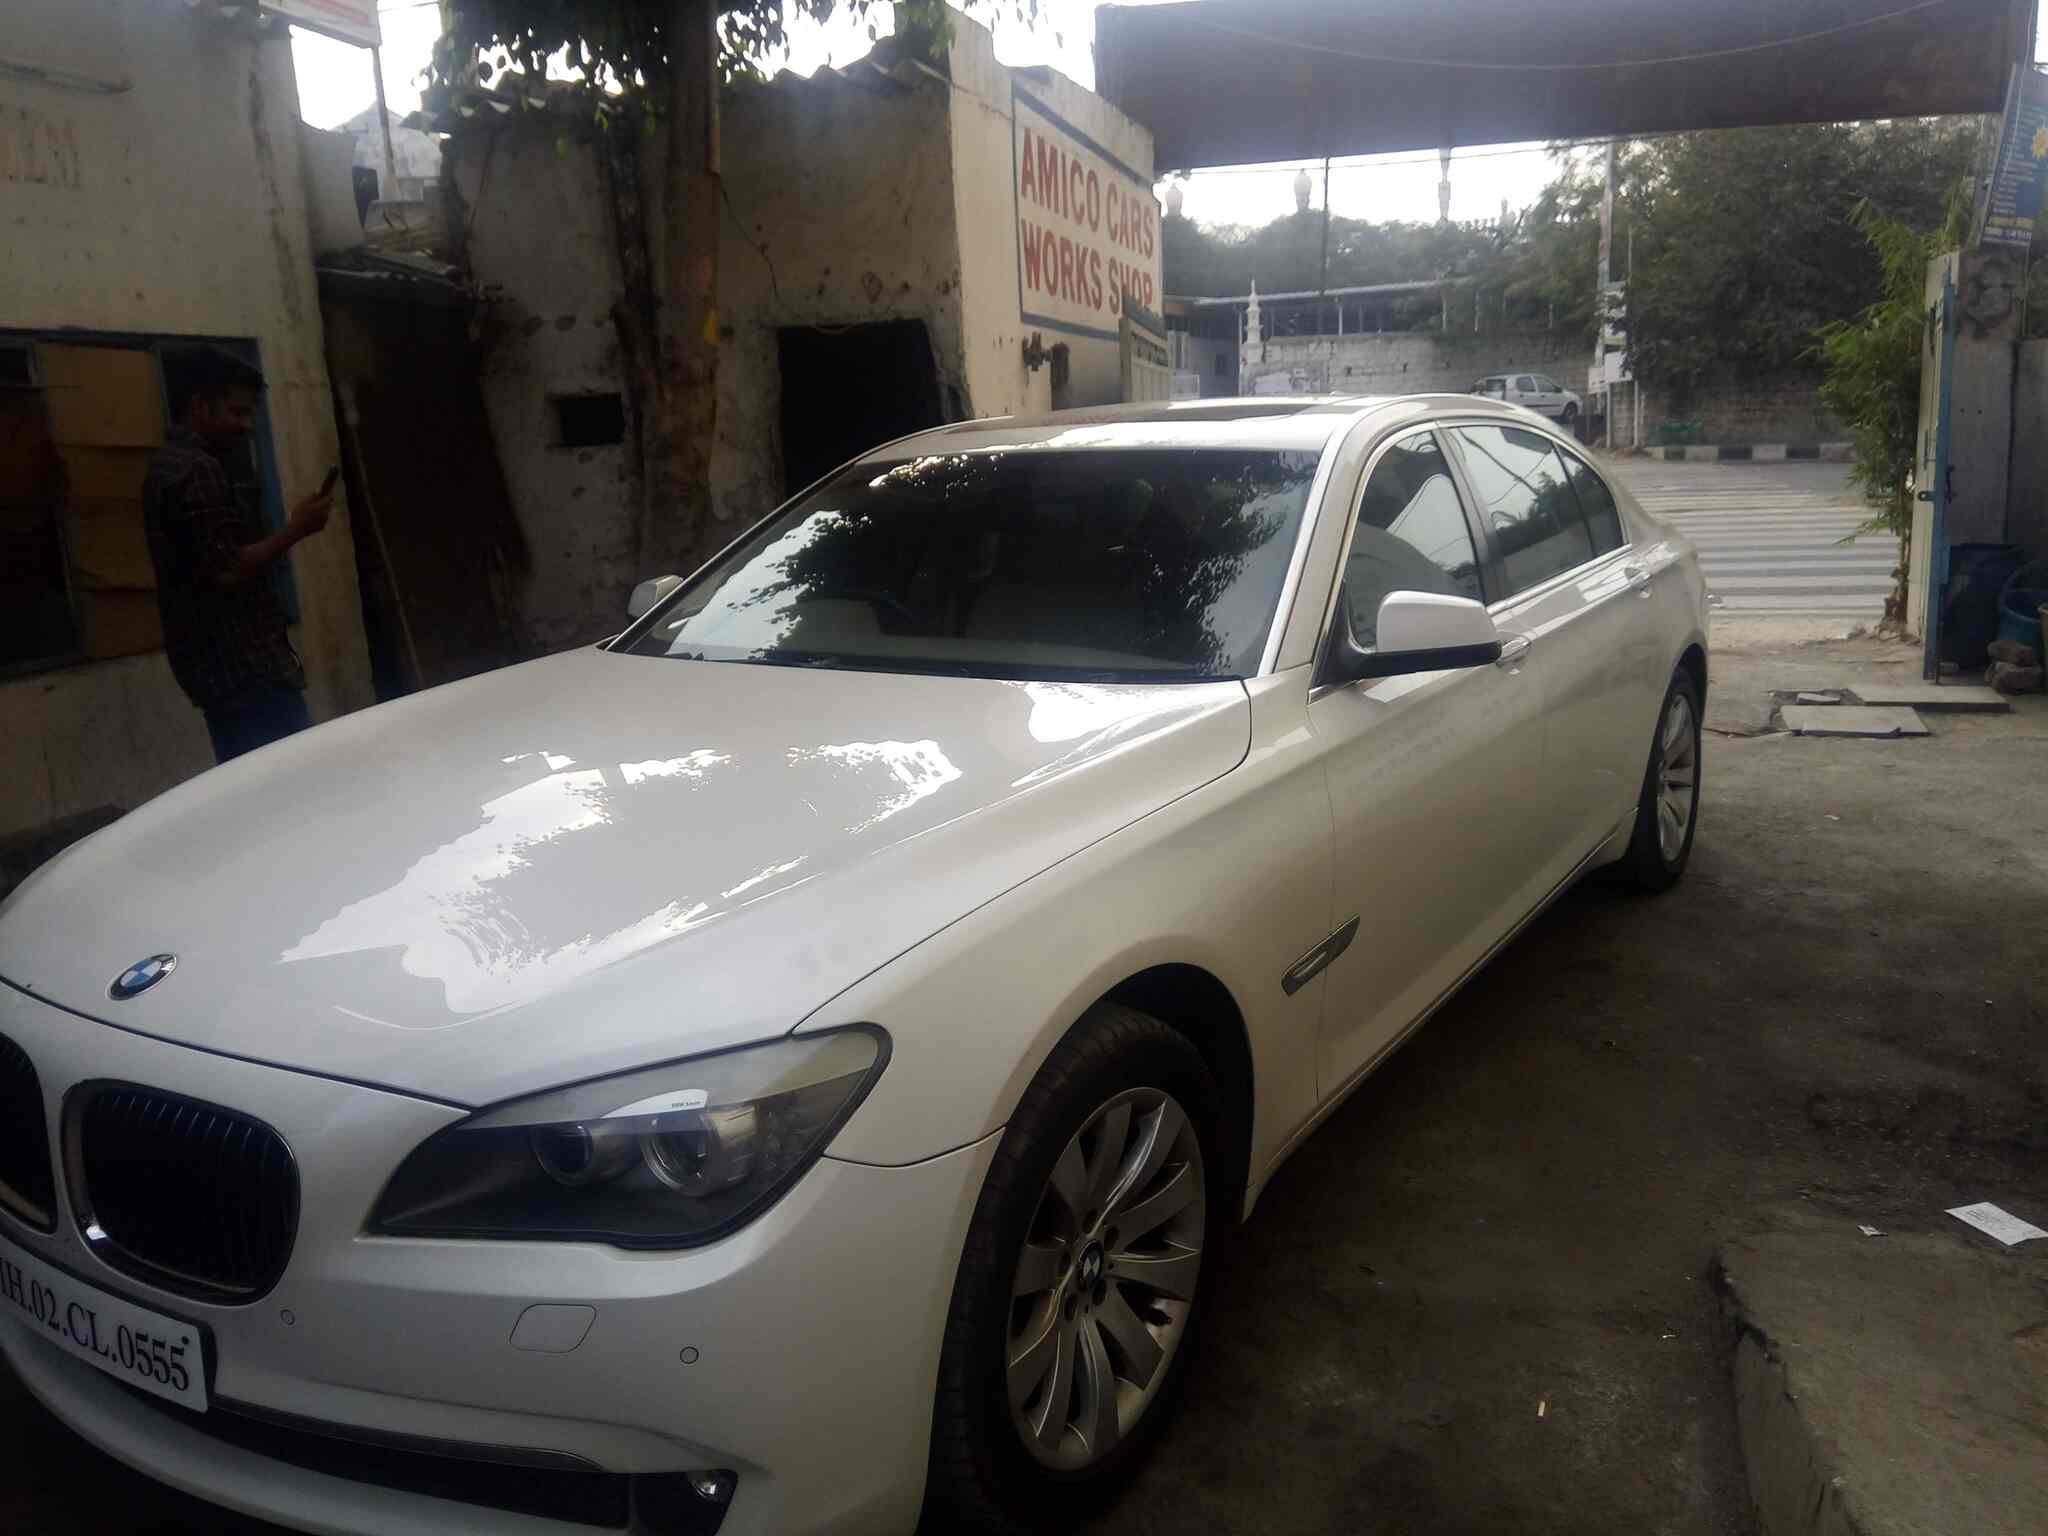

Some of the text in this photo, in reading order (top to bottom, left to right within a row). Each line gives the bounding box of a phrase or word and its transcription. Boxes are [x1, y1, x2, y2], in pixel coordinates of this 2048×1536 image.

[1021, 128, 1154, 260] AMICO CARS
[1022, 218, 1103, 311] WORKS
